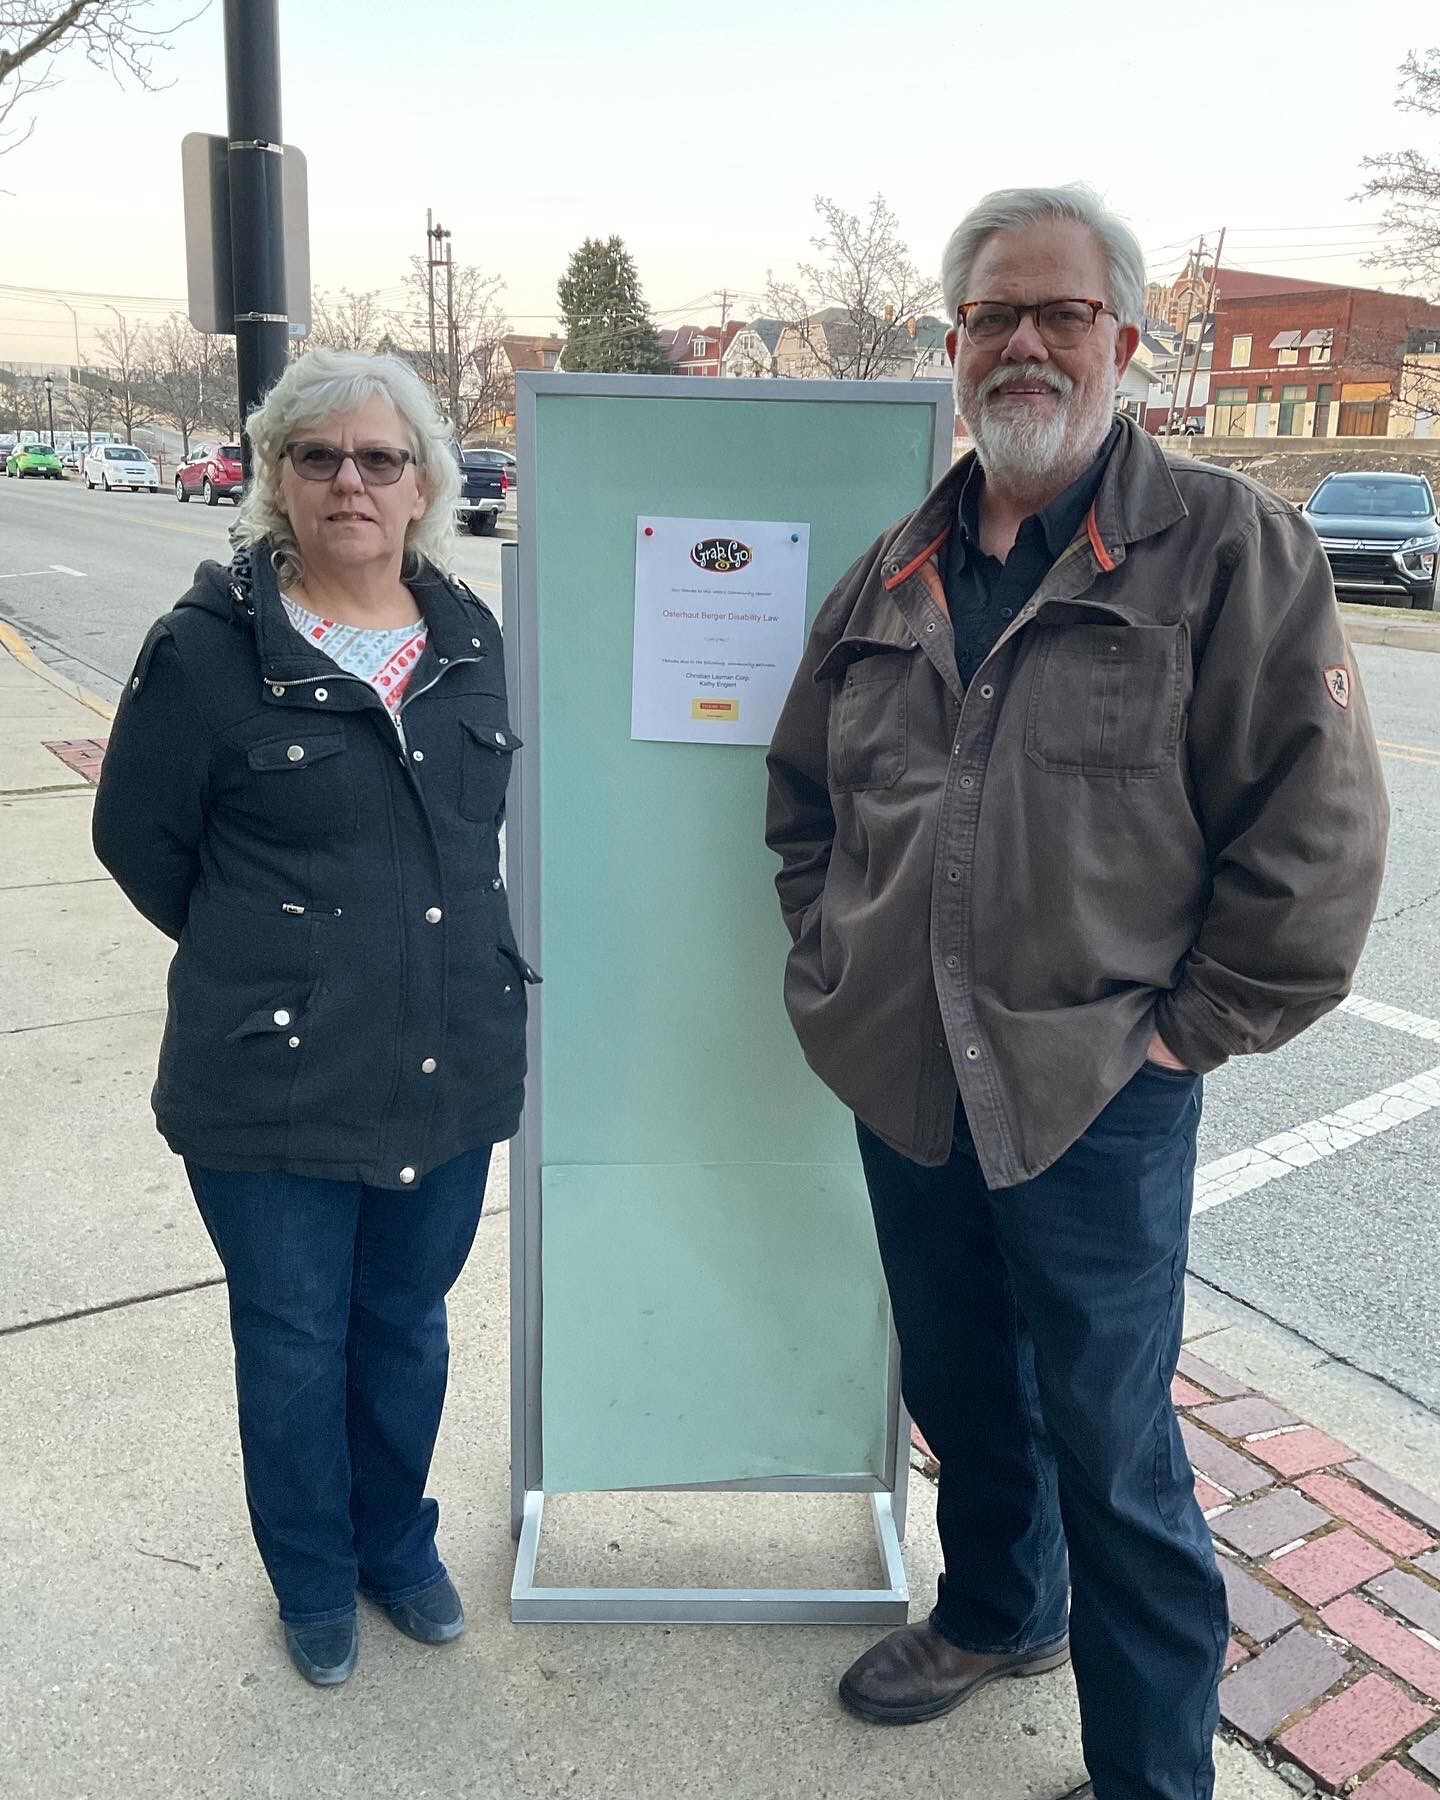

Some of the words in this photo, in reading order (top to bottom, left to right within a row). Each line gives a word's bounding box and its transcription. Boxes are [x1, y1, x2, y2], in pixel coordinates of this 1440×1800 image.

[692, 541, 727, 567] Grab
[728, 540, 749, 568] Go
[701, 612, 726, 621] Berger
[728, 613, 761, 622] Disability
[763, 614, 779, 622] Law
